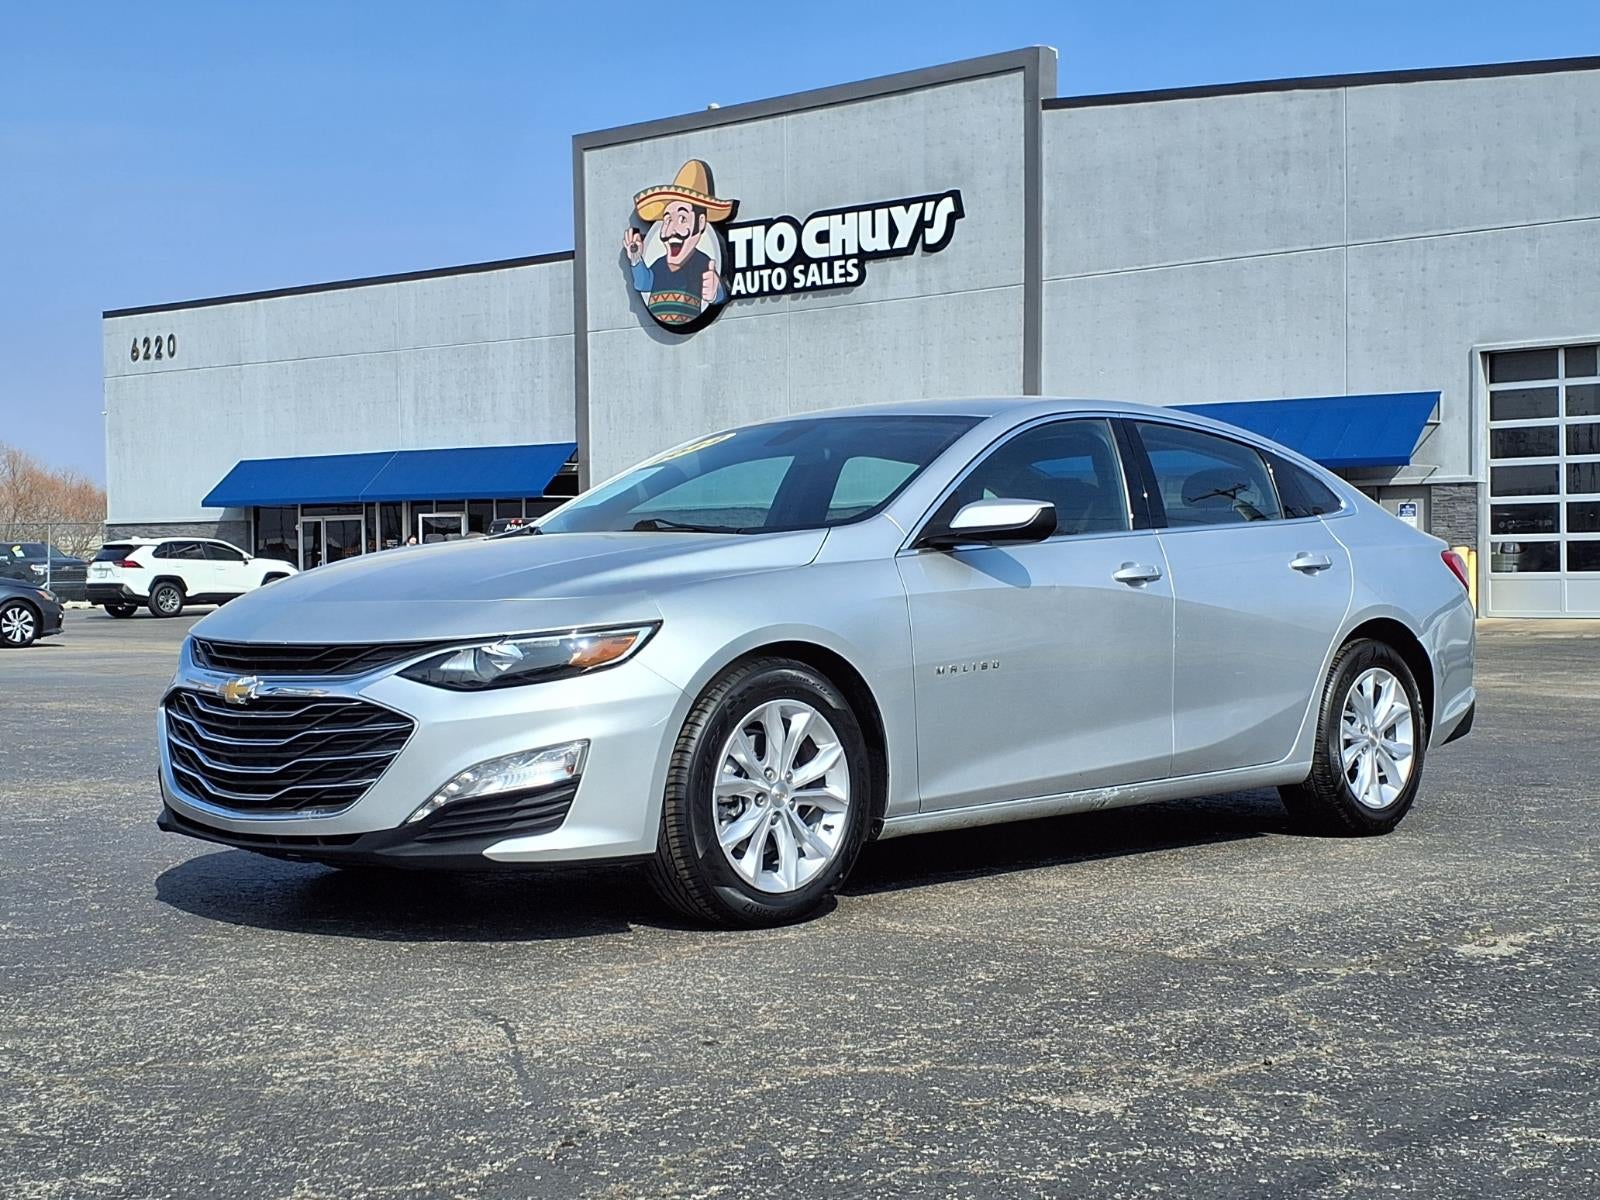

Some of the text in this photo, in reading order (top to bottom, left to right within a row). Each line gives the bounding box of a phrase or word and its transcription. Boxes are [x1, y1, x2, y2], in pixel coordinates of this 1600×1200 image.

[728, 196, 956, 269] TIO CHUY'S
[731, 258, 859, 296] AUTO SALES
[130, 333, 176, 362] 6220
[936, 659, 1000, 675] MALIBU
